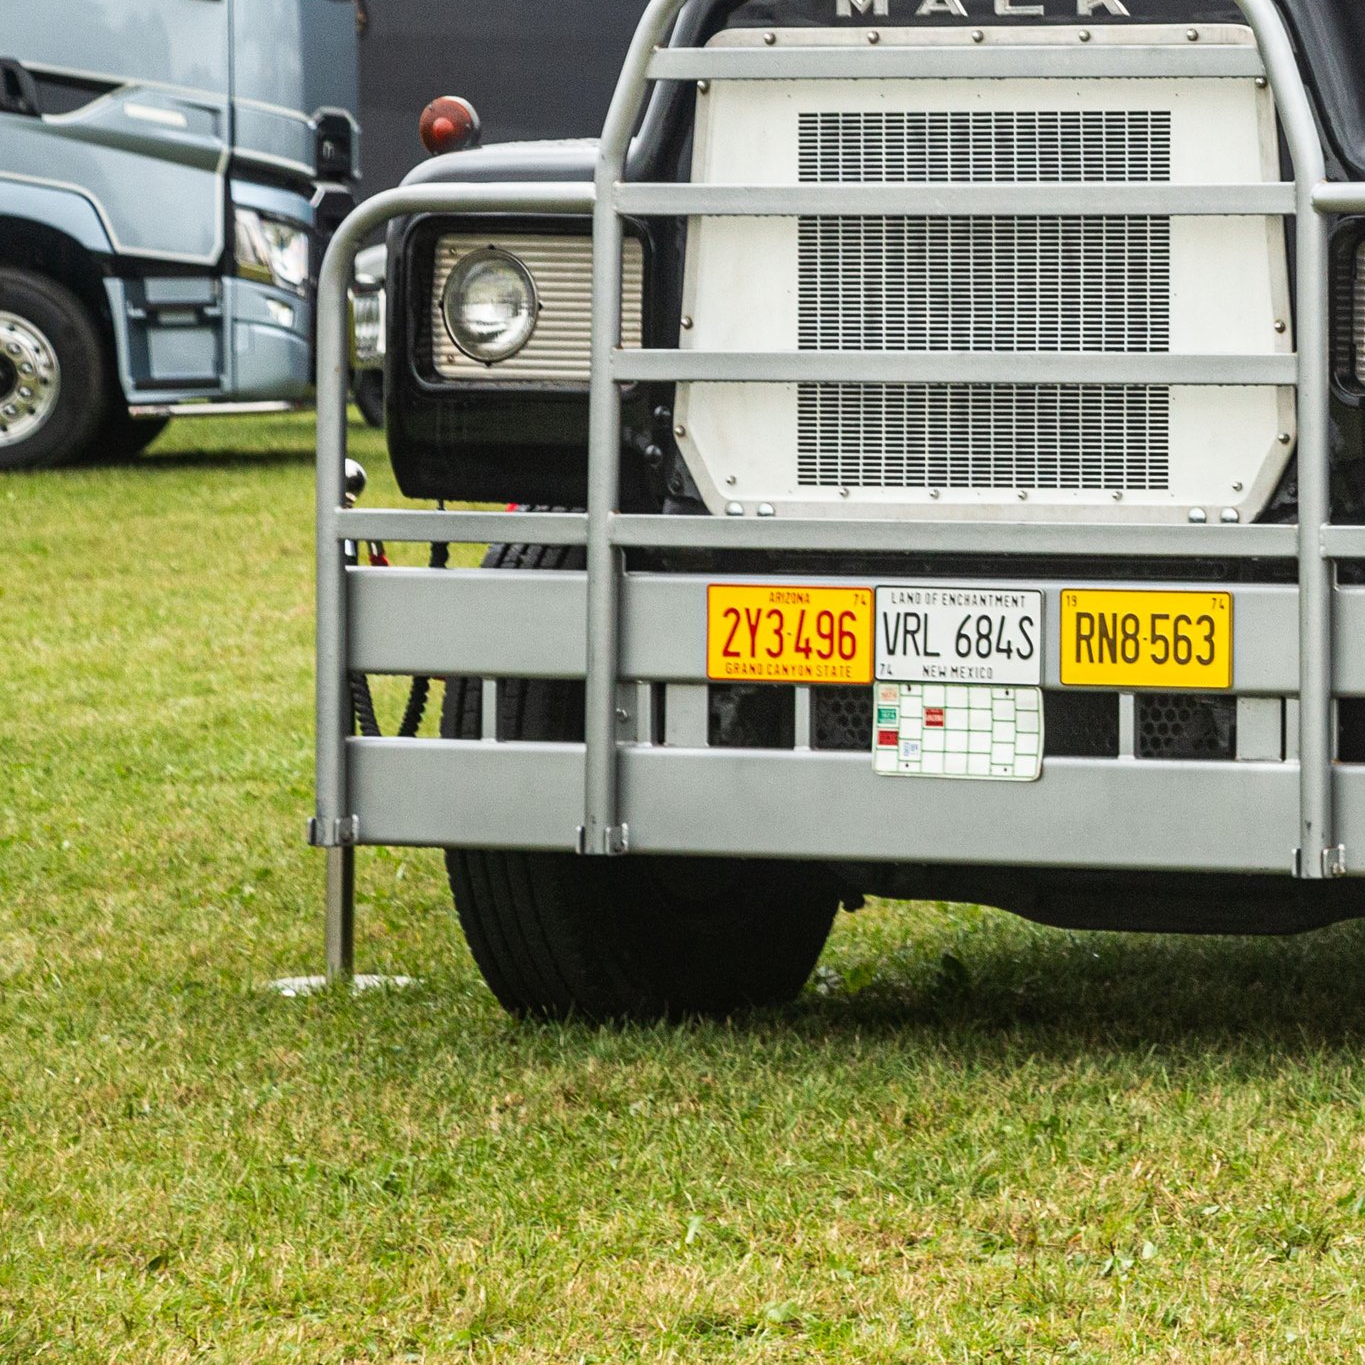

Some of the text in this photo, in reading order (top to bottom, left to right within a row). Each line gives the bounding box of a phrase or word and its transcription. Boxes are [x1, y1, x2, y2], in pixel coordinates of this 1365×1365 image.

[769, 591, 867, 606] ARIZONA 74
[891, 592, 1025, 608] LAND OF ENCHANTMENT
[1066, 595, 1225, 610] 19 74
[722, 607, 857, 660] 2Y3-496
[883, 611, 1034, 660] VRL 684S
[1076, 612, 1215, 666] RN8-563
[725, 662, 852, 678] GRAND CANYON STATE
[880, 663, 993, 679] 74 NEW MEXICO
